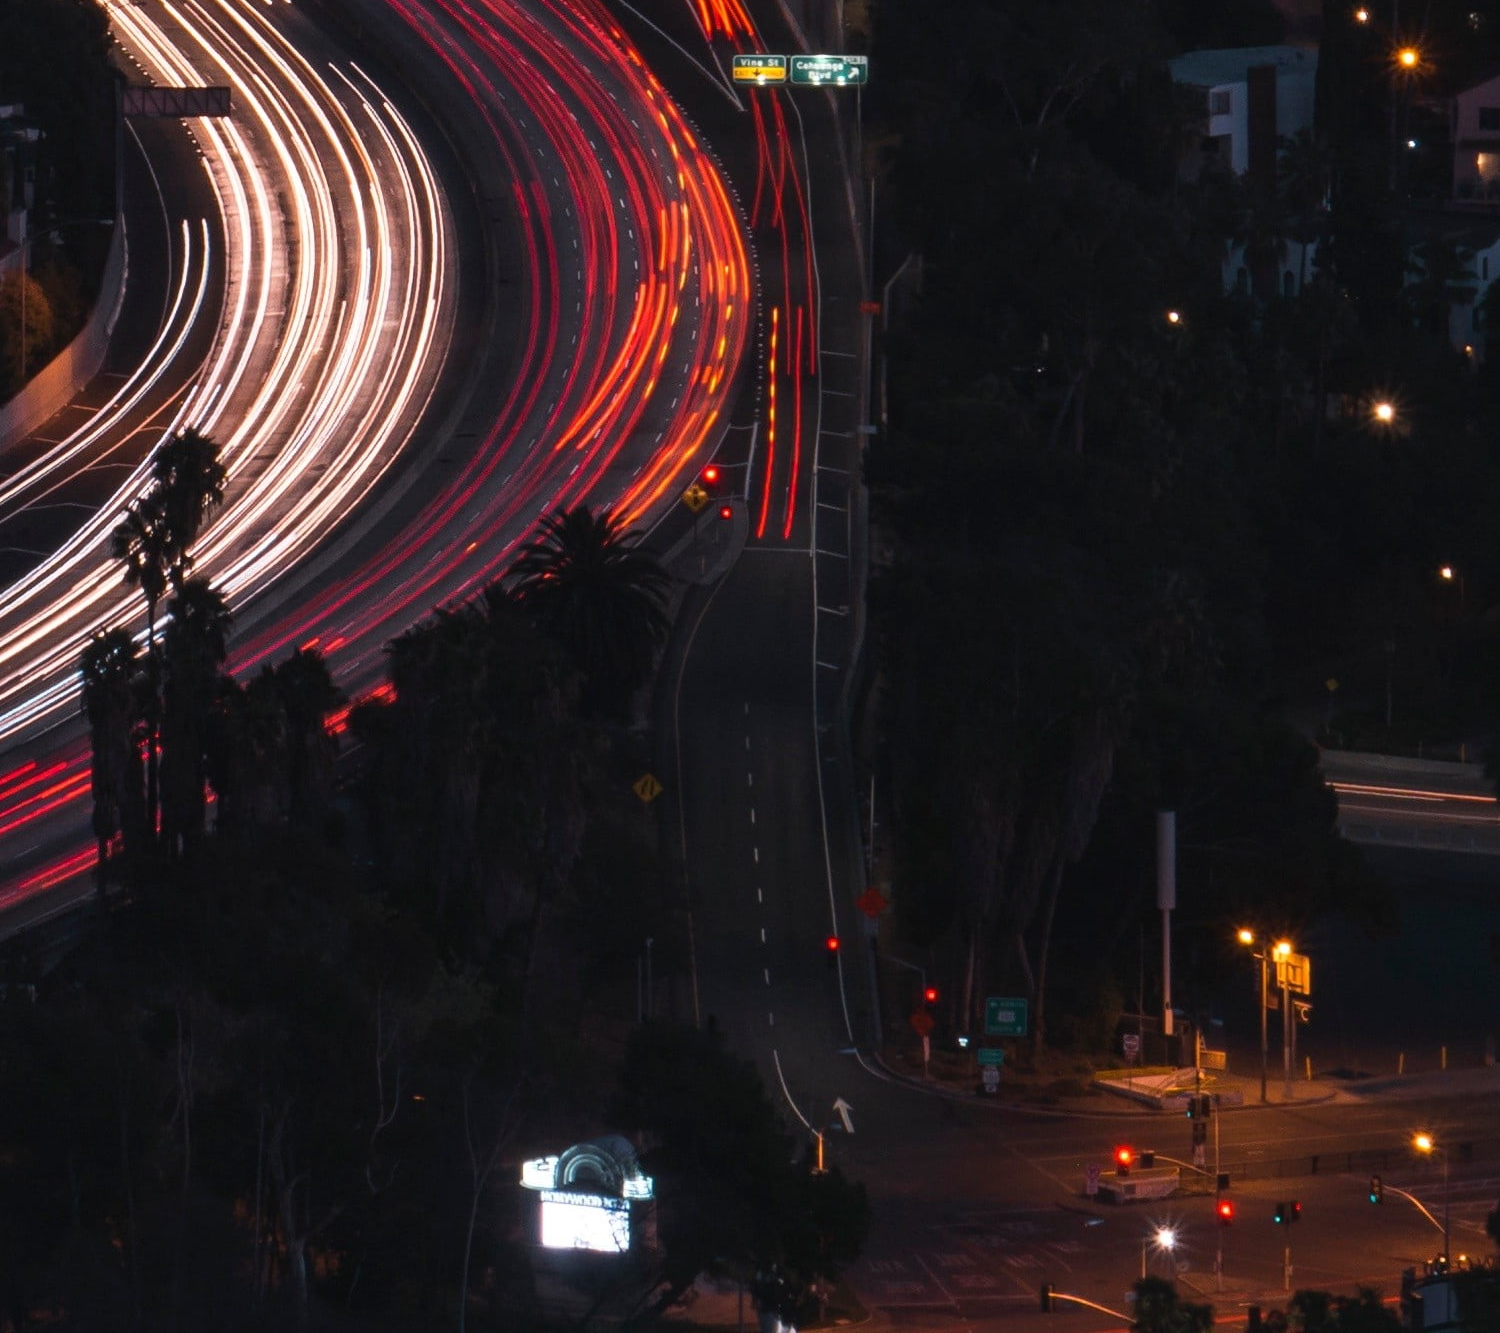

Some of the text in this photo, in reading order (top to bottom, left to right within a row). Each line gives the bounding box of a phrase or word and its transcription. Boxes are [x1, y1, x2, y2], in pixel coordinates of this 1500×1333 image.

[740, 58, 780, 67] Vine St
[796, 60, 845, 71] Cahuenga
[808, 70, 832, 80] Blvd
